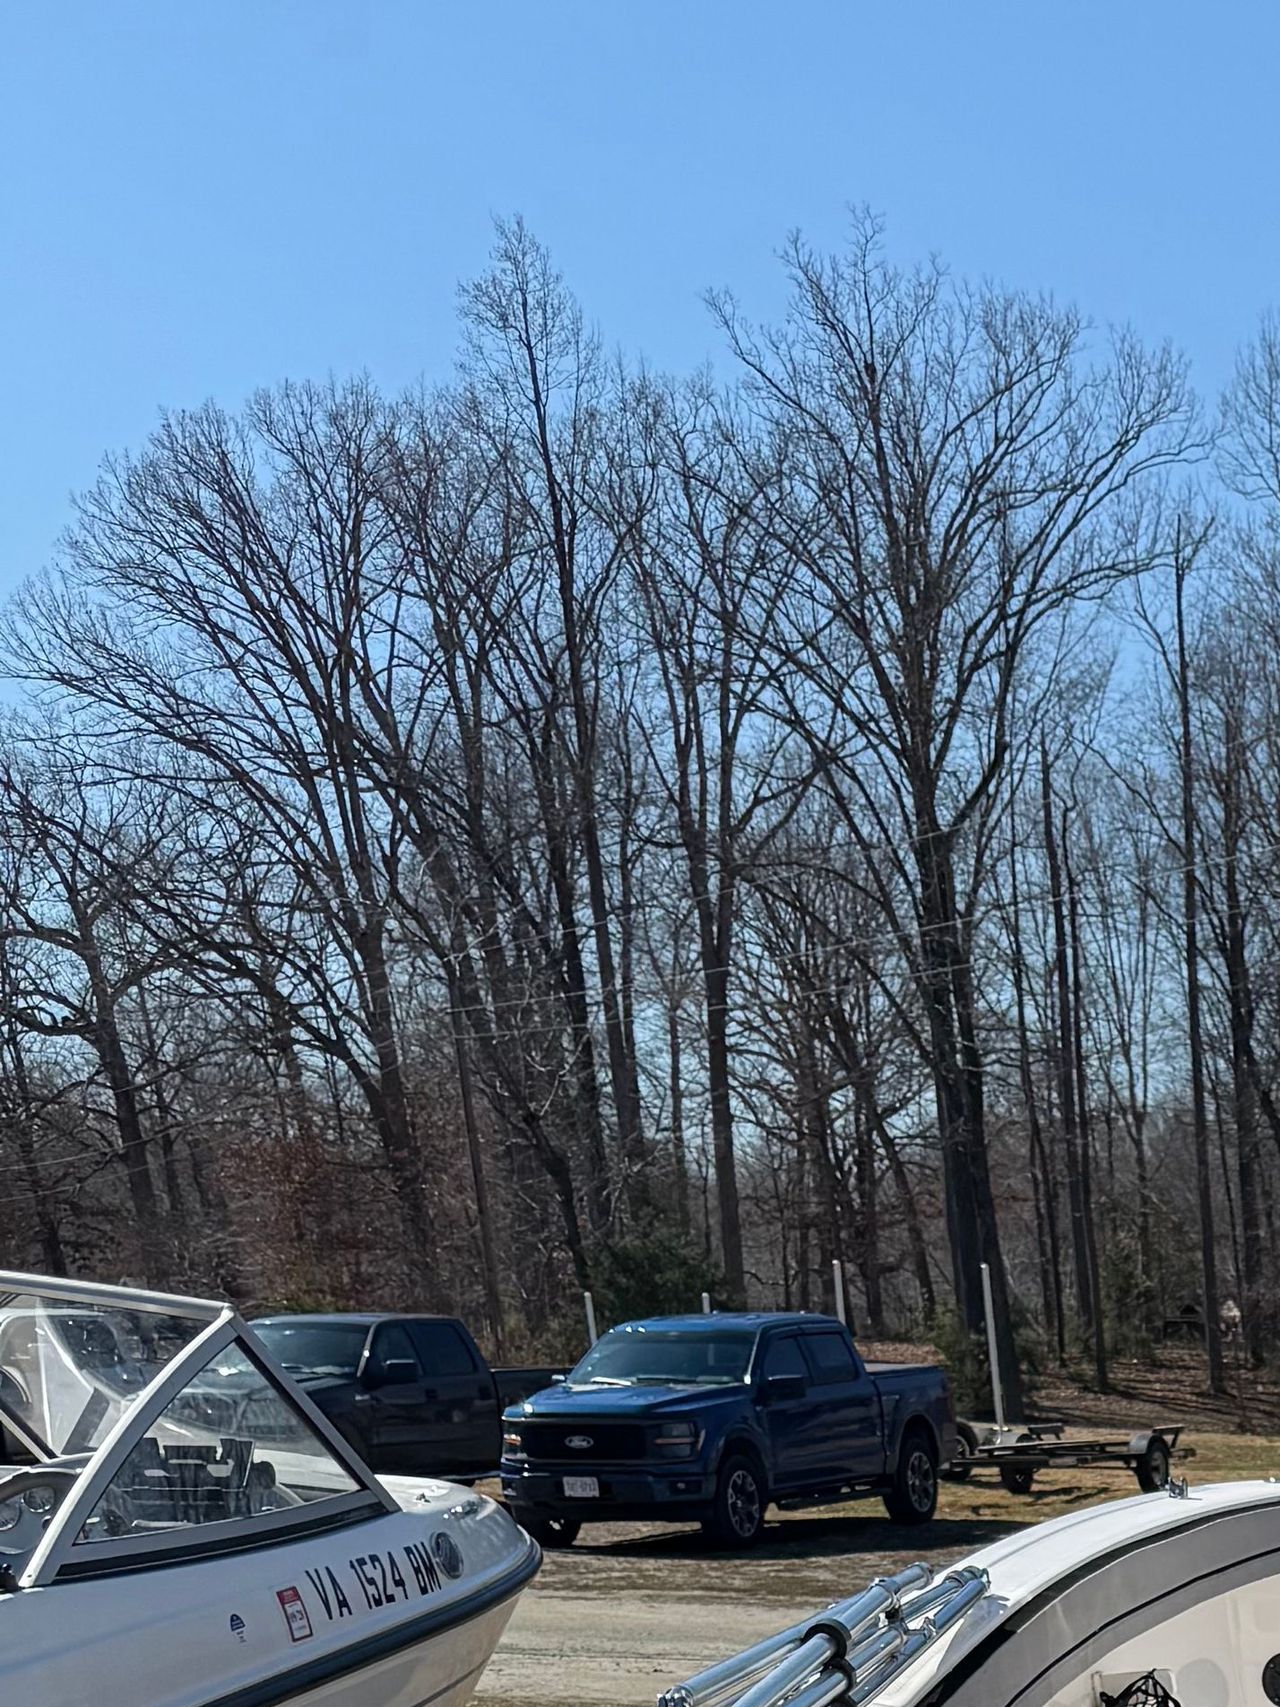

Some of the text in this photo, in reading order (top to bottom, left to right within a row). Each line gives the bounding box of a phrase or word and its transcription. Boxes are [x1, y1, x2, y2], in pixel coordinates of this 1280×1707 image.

[304, 1541, 442, 1620] VA 1524 BM
